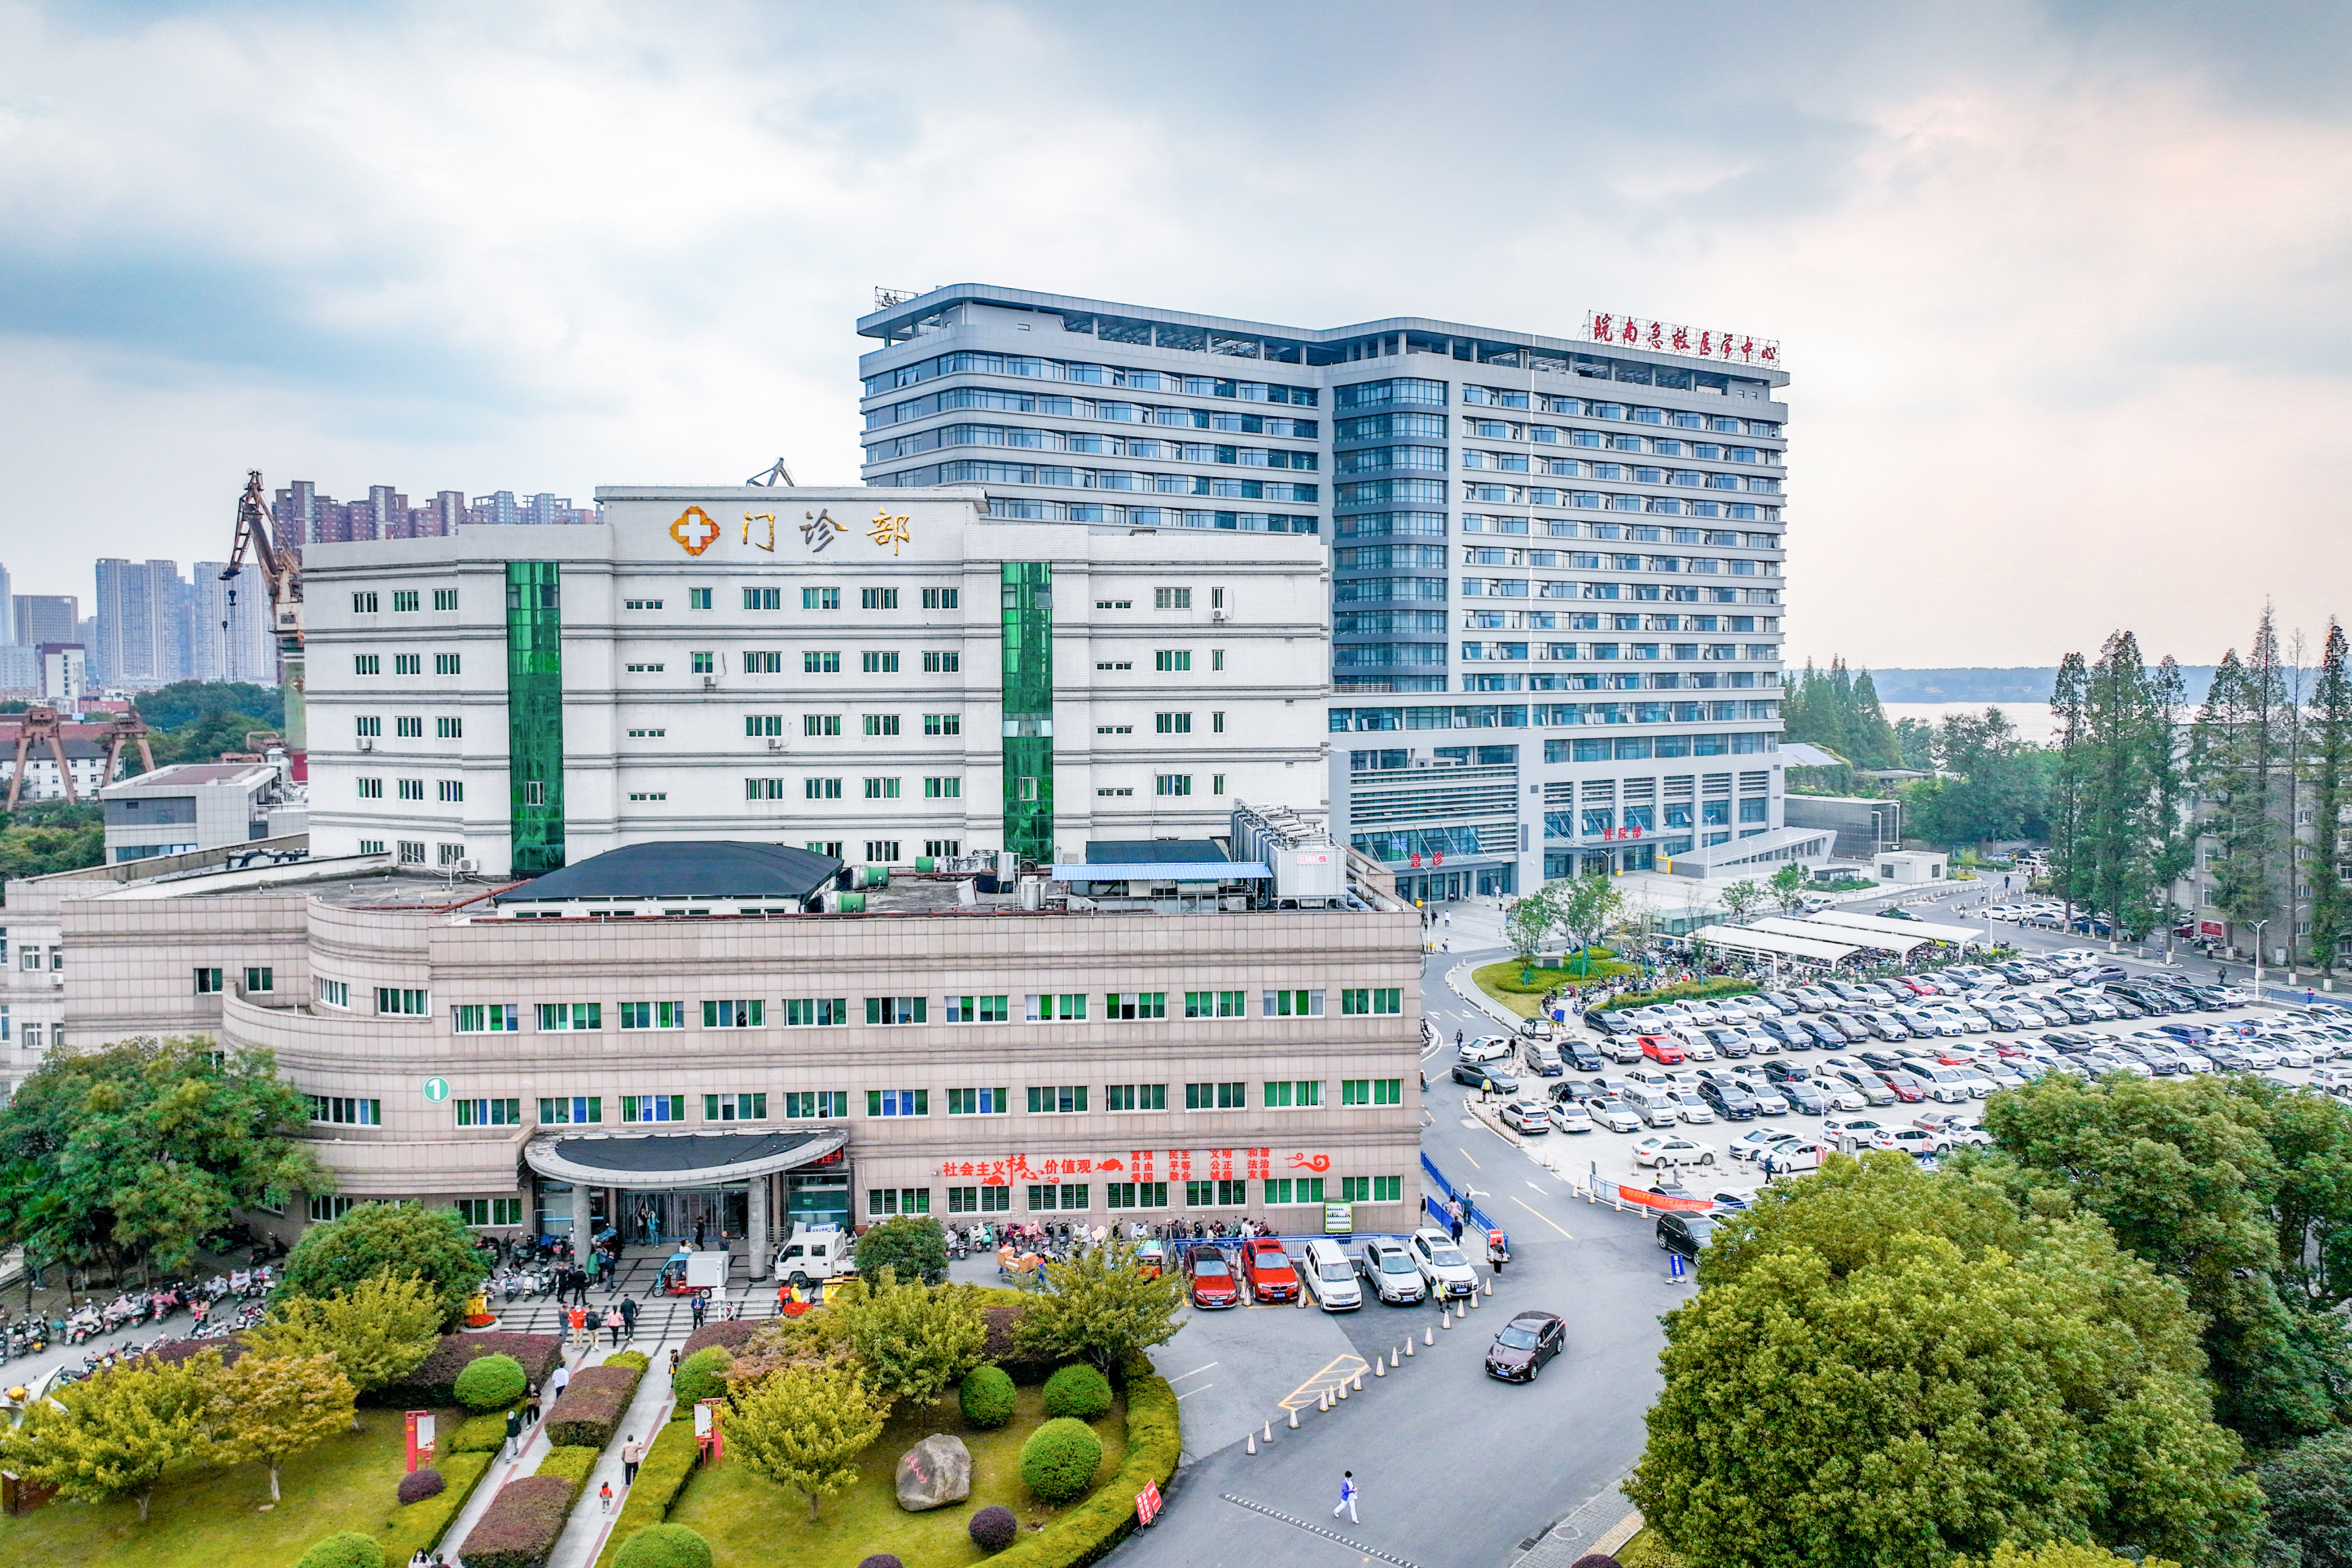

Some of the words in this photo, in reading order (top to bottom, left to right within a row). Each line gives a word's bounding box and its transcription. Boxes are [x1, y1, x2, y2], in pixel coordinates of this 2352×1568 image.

[1594, 314, 1776, 361] 皖南急救医学中心
[742, 507, 909, 556] 门诊部
[1604, 826, 1642, 841] 住院部
[1411, 852, 1444, 867] 急诊
[429, 1079, 440, 1100] 1
[1131, 1151, 1153, 1160] 富强
[1169, 1150, 1190, 1160] 民主
[1210, 1149, 1232, 1159] 文明
[1248, 1147, 1270, 1158] 和谐
[943, 1153, 1092, 1187] 社会主义核心价值观
[1132, 1162, 1153, 1172] 自由
[1169, 1161, 1191, 1171] 平等
[1210, 1160, 1233, 1170] 公正
[1248, 1159, 1270, 1169] 法治
[1131, 1173, 1153, 1183] 爱国
[1169, 1171, 1191, 1181] 敬业
[1210, 1170, 1233, 1181] 诚信
[1248, 1169, 1269, 1180] 友善
